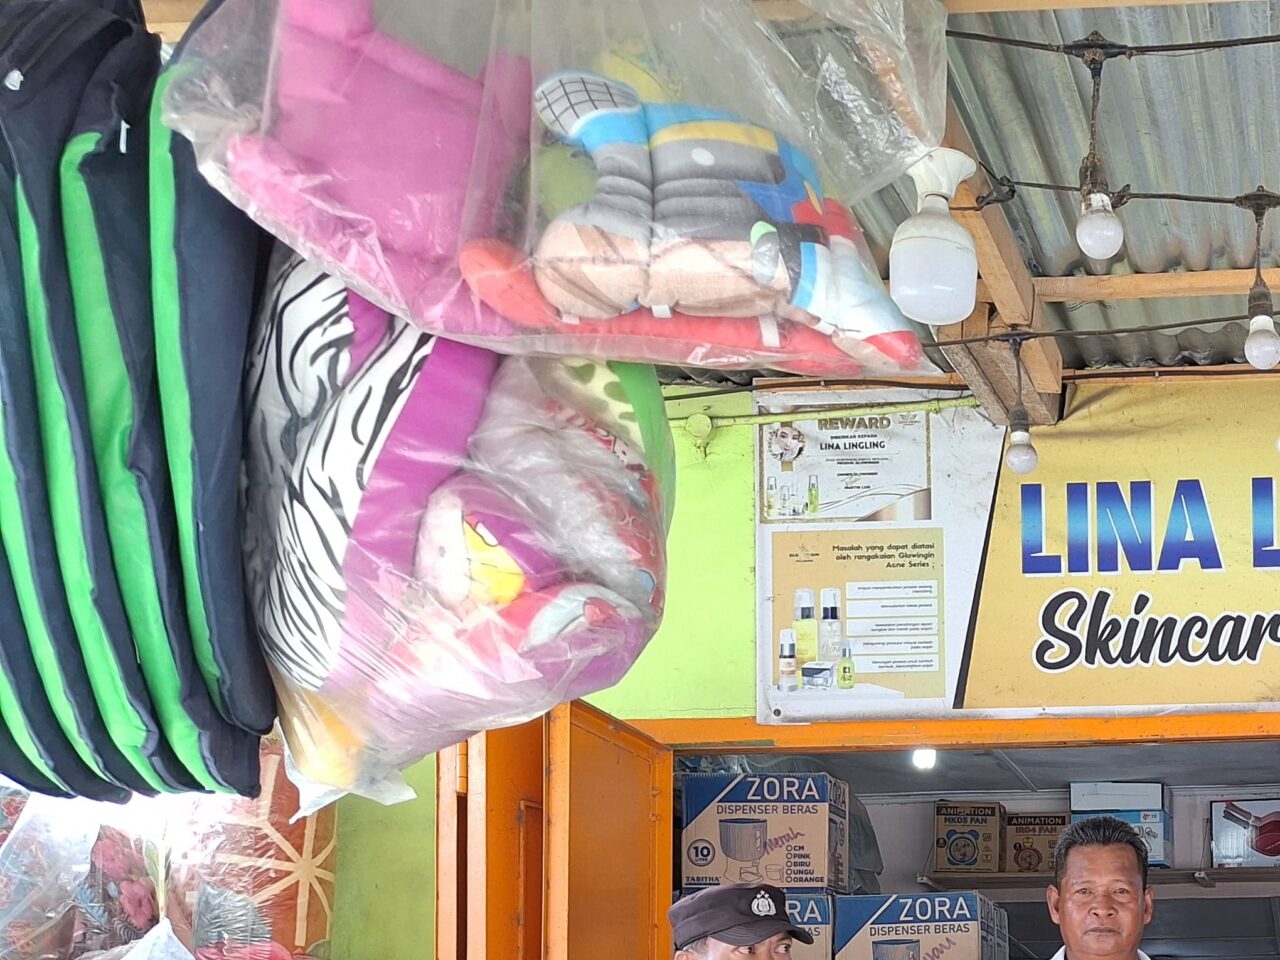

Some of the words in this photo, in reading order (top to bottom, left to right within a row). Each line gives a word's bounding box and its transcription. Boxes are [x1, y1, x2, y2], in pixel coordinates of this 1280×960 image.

[818, 417, 891, 431] REWARD
[820, 442, 841, 450] LINA
[843, 440, 886, 450] LINGLING
[1019, 479, 1225, 576] LINA
[866, 544, 884, 552] yang
[887, 543, 909, 552] dapat
[911, 542, 935, 550] diatasi
[898, 551, 935, 562] Glowingin
[908, 560, 930, 568] Series
[746, 777, 820, 800] ZORA
[716, 804, 779, 815] DISPENSER
[782, 804, 818, 815] BERAS
[1011, 817, 1062, 825] ANIMATION
[692, 846, 711, 859] 10
[786, 900, 823, 923] RA
[898, 896, 972, 922] ZORA
[869, 924, 931, 937] DISPENSER
[934, 923, 971, 934] BERAS
